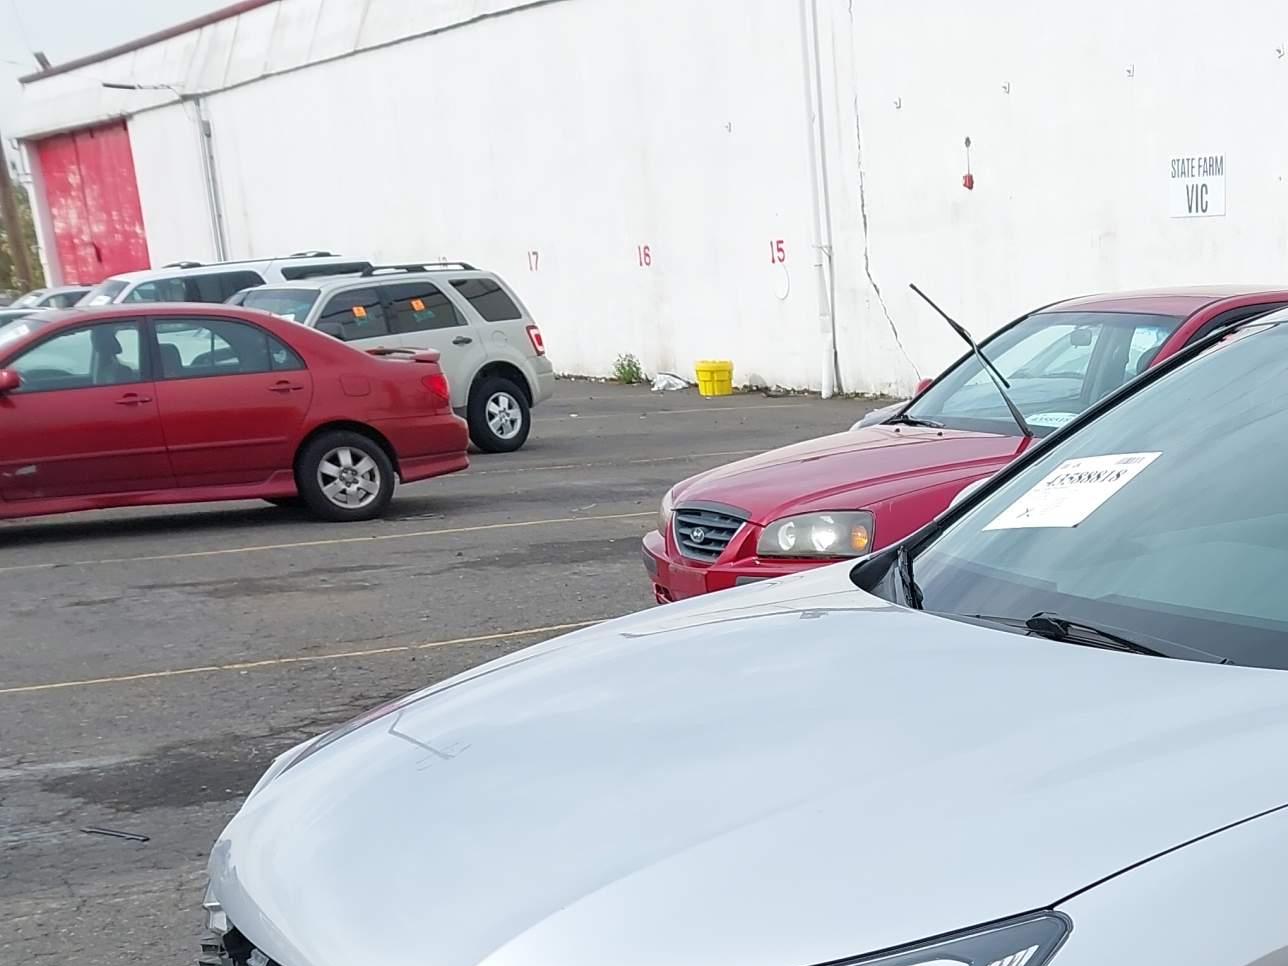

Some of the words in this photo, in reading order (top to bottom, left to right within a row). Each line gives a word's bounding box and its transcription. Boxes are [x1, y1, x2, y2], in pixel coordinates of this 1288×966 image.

[1171, 157, 1196, 179] STATE
[1197, 155, 1224, 178] FARM
[1185, 183, 1209, 214] VIC
[527, 250, 539, 272] 17
[637, 245, 652, 267] 16
[769, 239, 786, 264] 15
